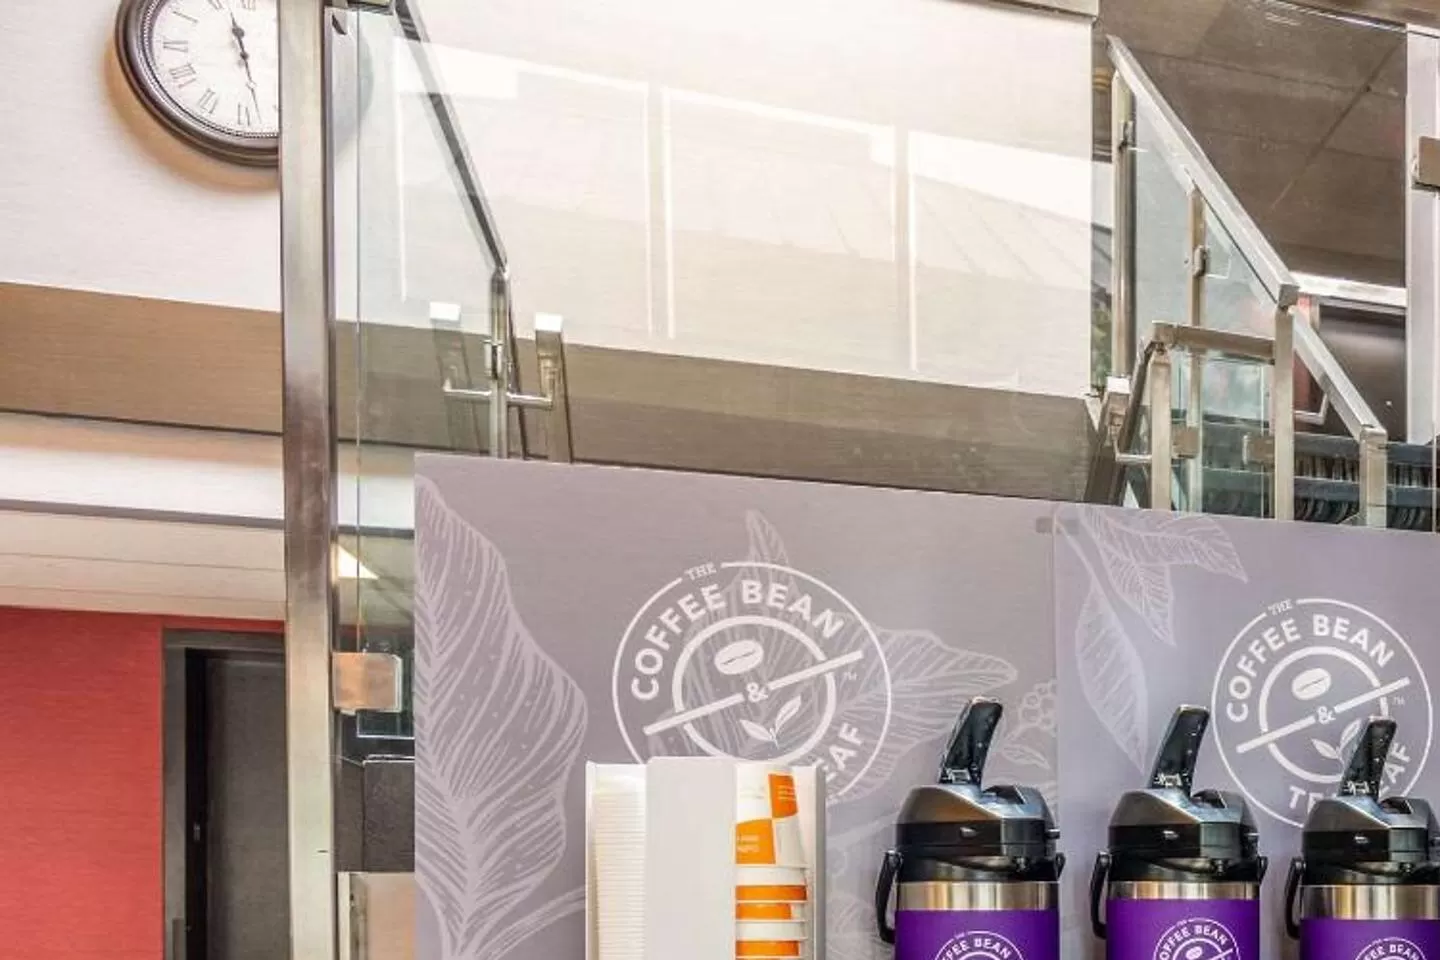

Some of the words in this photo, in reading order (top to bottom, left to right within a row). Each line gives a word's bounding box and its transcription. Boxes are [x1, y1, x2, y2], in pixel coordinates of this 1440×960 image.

[683, 562, 717, 581] THE
[630, 583, 727, 701] COFFEE
[741, 579, 845, 640] BEAN
[1226, 618, 1302, 723] COFFEE
[1313, 613, 1395, 668] BEAN
[746, 682, 769, 702] &
[1317, 706, 1336, 724] &
[812, 722, 863, 783] AF
[1194, 924, 1229, 946] BEAN
[973, 937, 1012, 960] BEAN
